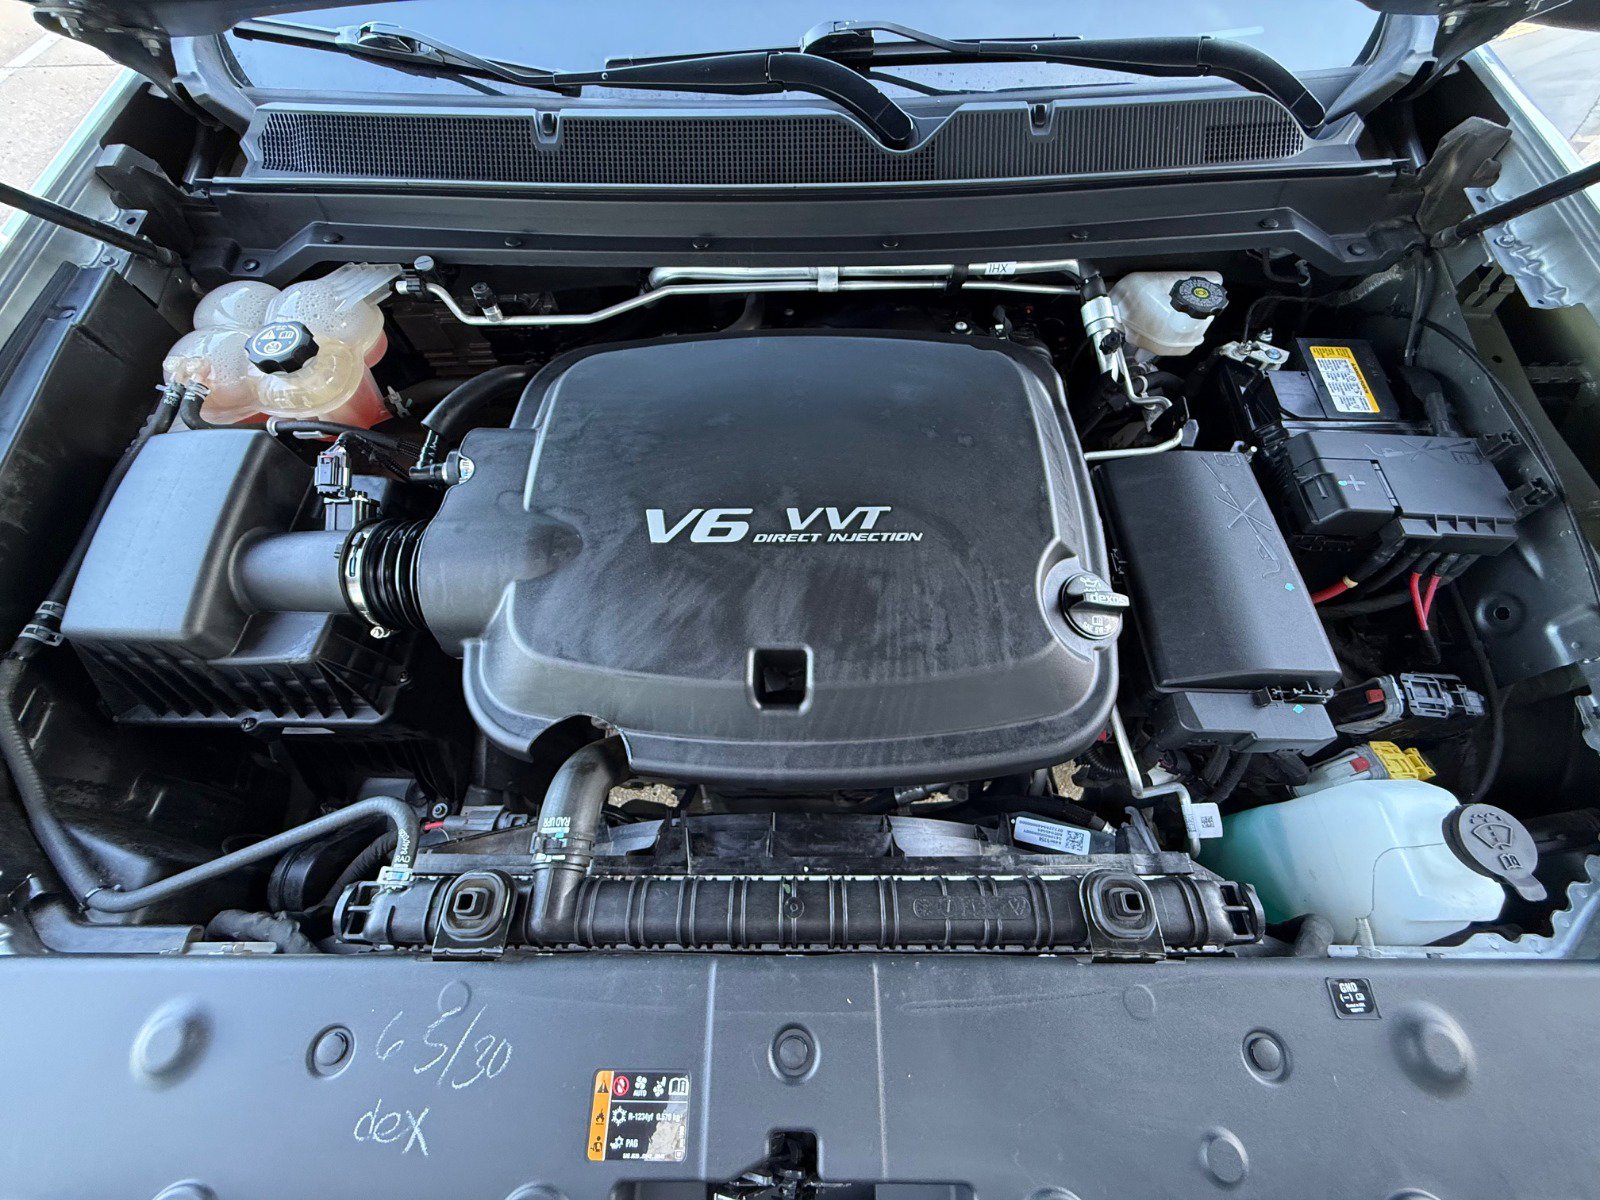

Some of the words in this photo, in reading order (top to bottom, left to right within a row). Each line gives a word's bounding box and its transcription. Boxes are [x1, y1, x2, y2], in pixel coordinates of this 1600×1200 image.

[645, 508, 754, 543] V6
[786, 506, 892, 531] VVT
[752, 533, 822, 543] DIRECT
[826, 532, 924, 542] INJECTION
[394, 855, 411, 863] RAD
[1339, 982, 1358, 993] GND
[353, 1098, 430, 1157] dex
[625, 1138, 639, 1148] PAG
